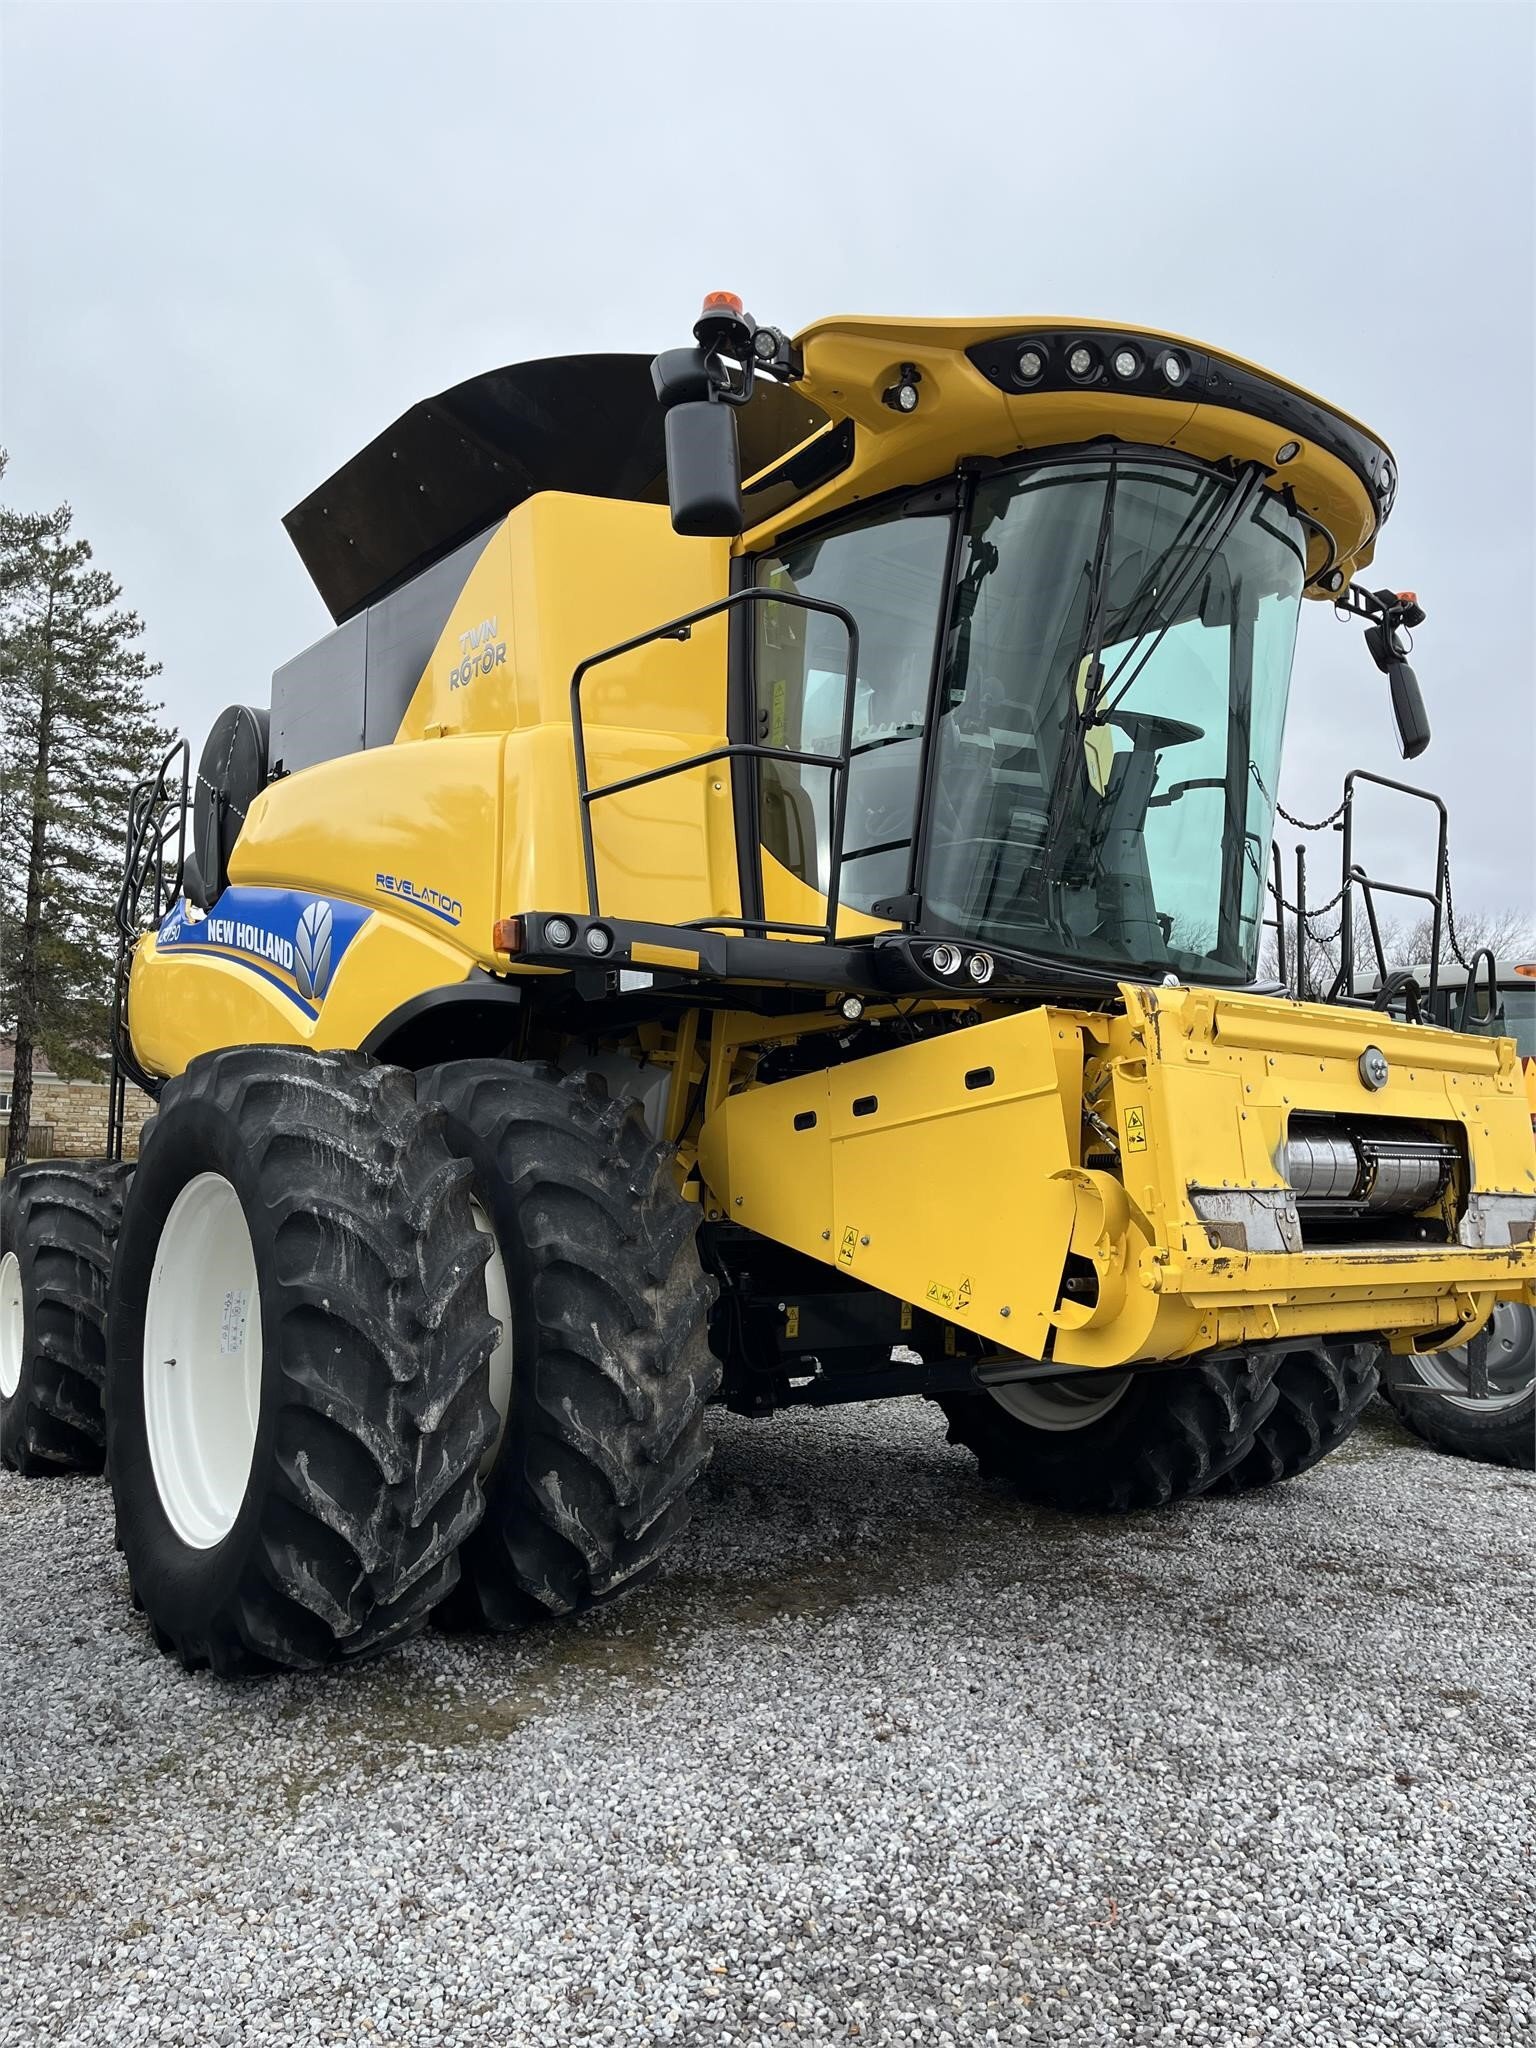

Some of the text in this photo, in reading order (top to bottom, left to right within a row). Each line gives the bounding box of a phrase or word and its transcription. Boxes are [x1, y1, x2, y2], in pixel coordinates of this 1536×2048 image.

[459, 615, 497, 655] TWIN
[450, 642, 507, 691] ROTOR
[376, 873, 462, 917] REVELATION
[207, 919, 294, 970] NEW HOLLAND
